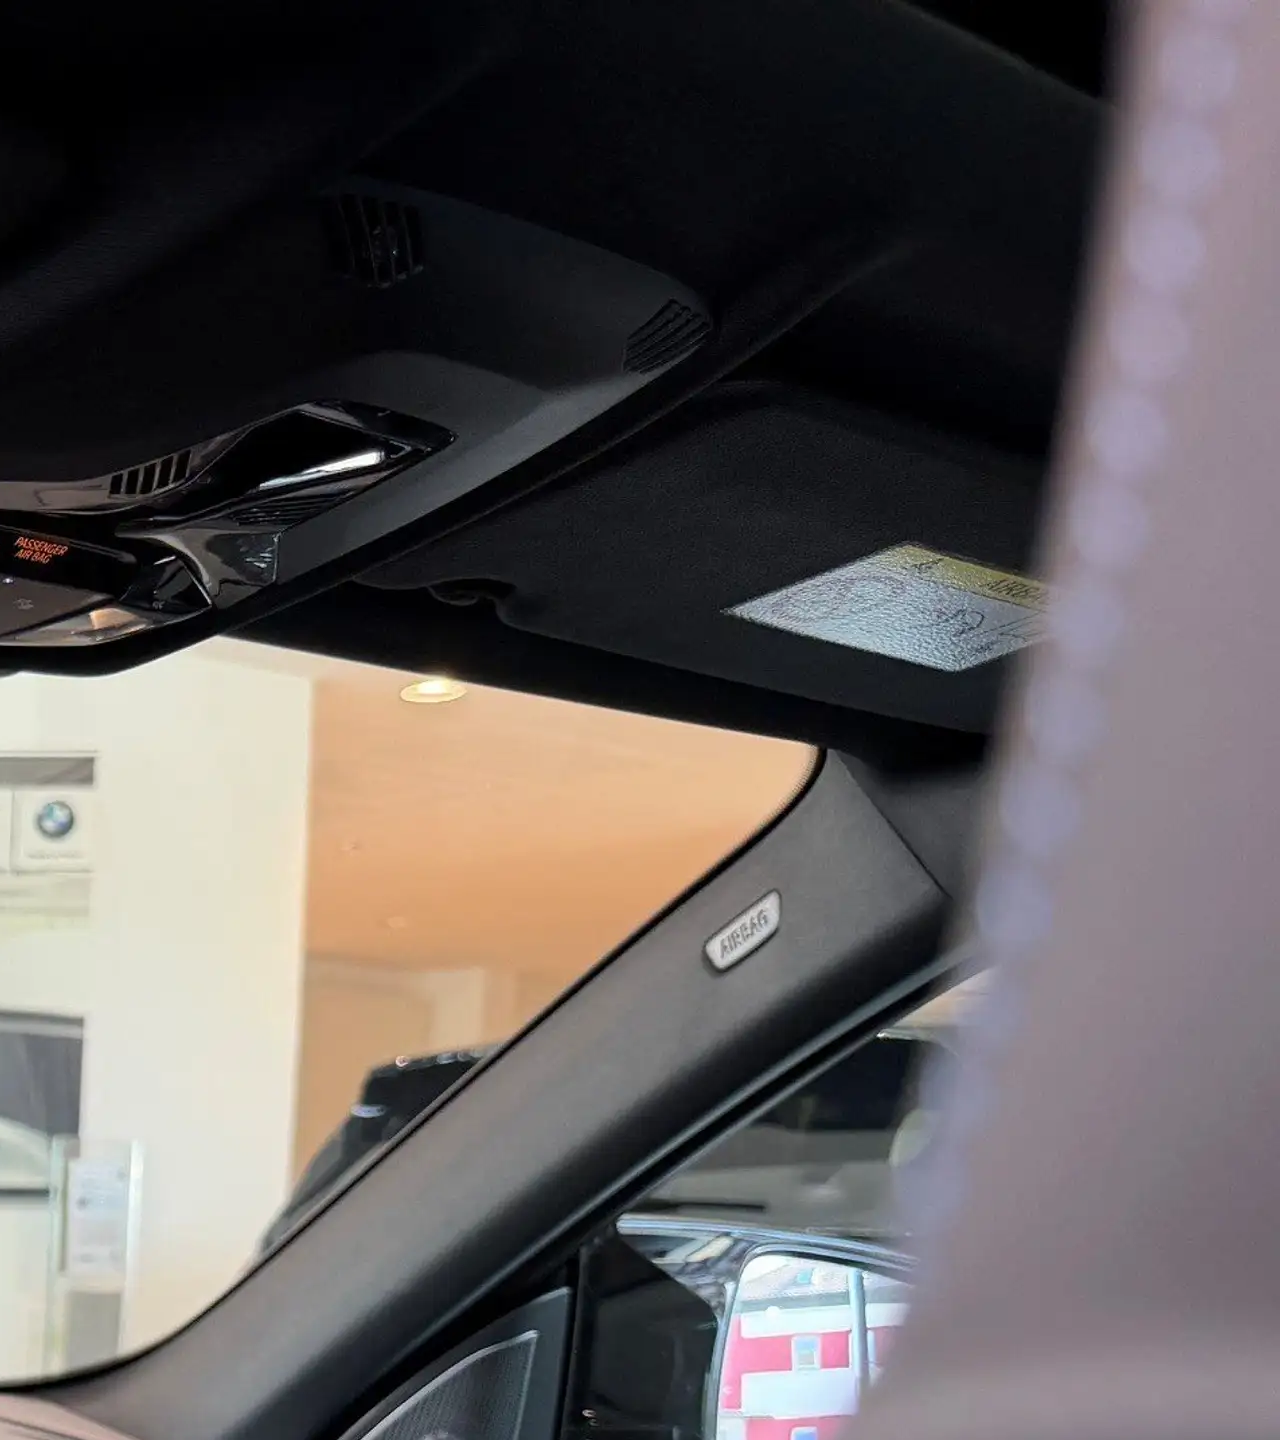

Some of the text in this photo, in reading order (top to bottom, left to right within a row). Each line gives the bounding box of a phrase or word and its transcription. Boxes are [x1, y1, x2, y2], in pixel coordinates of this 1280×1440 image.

[14, 536, 69, 557] PASSENGER
[14, 548, 52, 564] AIR BAG
[719, 908, 768, 960] AIRBAG
